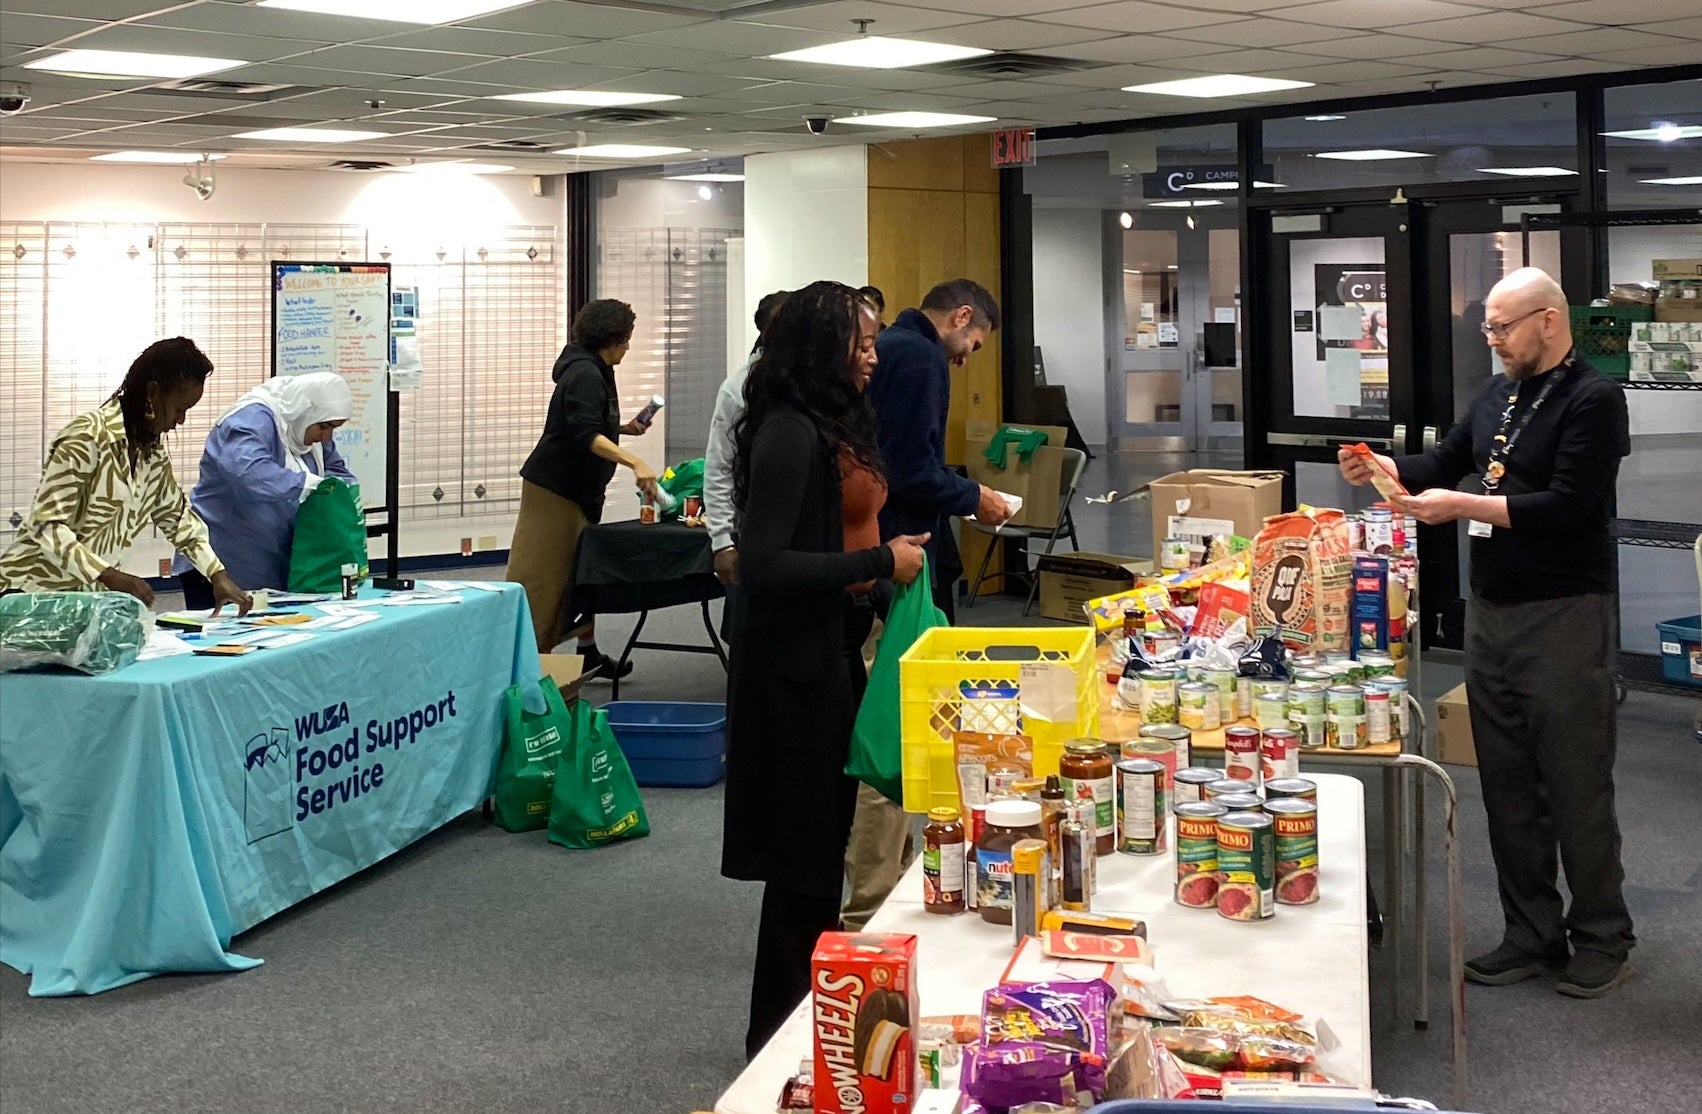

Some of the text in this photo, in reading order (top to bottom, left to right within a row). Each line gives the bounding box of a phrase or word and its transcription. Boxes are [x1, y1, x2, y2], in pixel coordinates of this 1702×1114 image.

[994, 128, 1033, 164] EXIT
[1205, 171, 1239, 180] CAMP
[279, 327, 299, 340] FOOD
[296, 690, 456, 782] Food Support
[296, 763, 383, 821] Service
[1180, 820, 1217, 835] PRIMO
[1278, 819, 1315, 832] PRIMO
